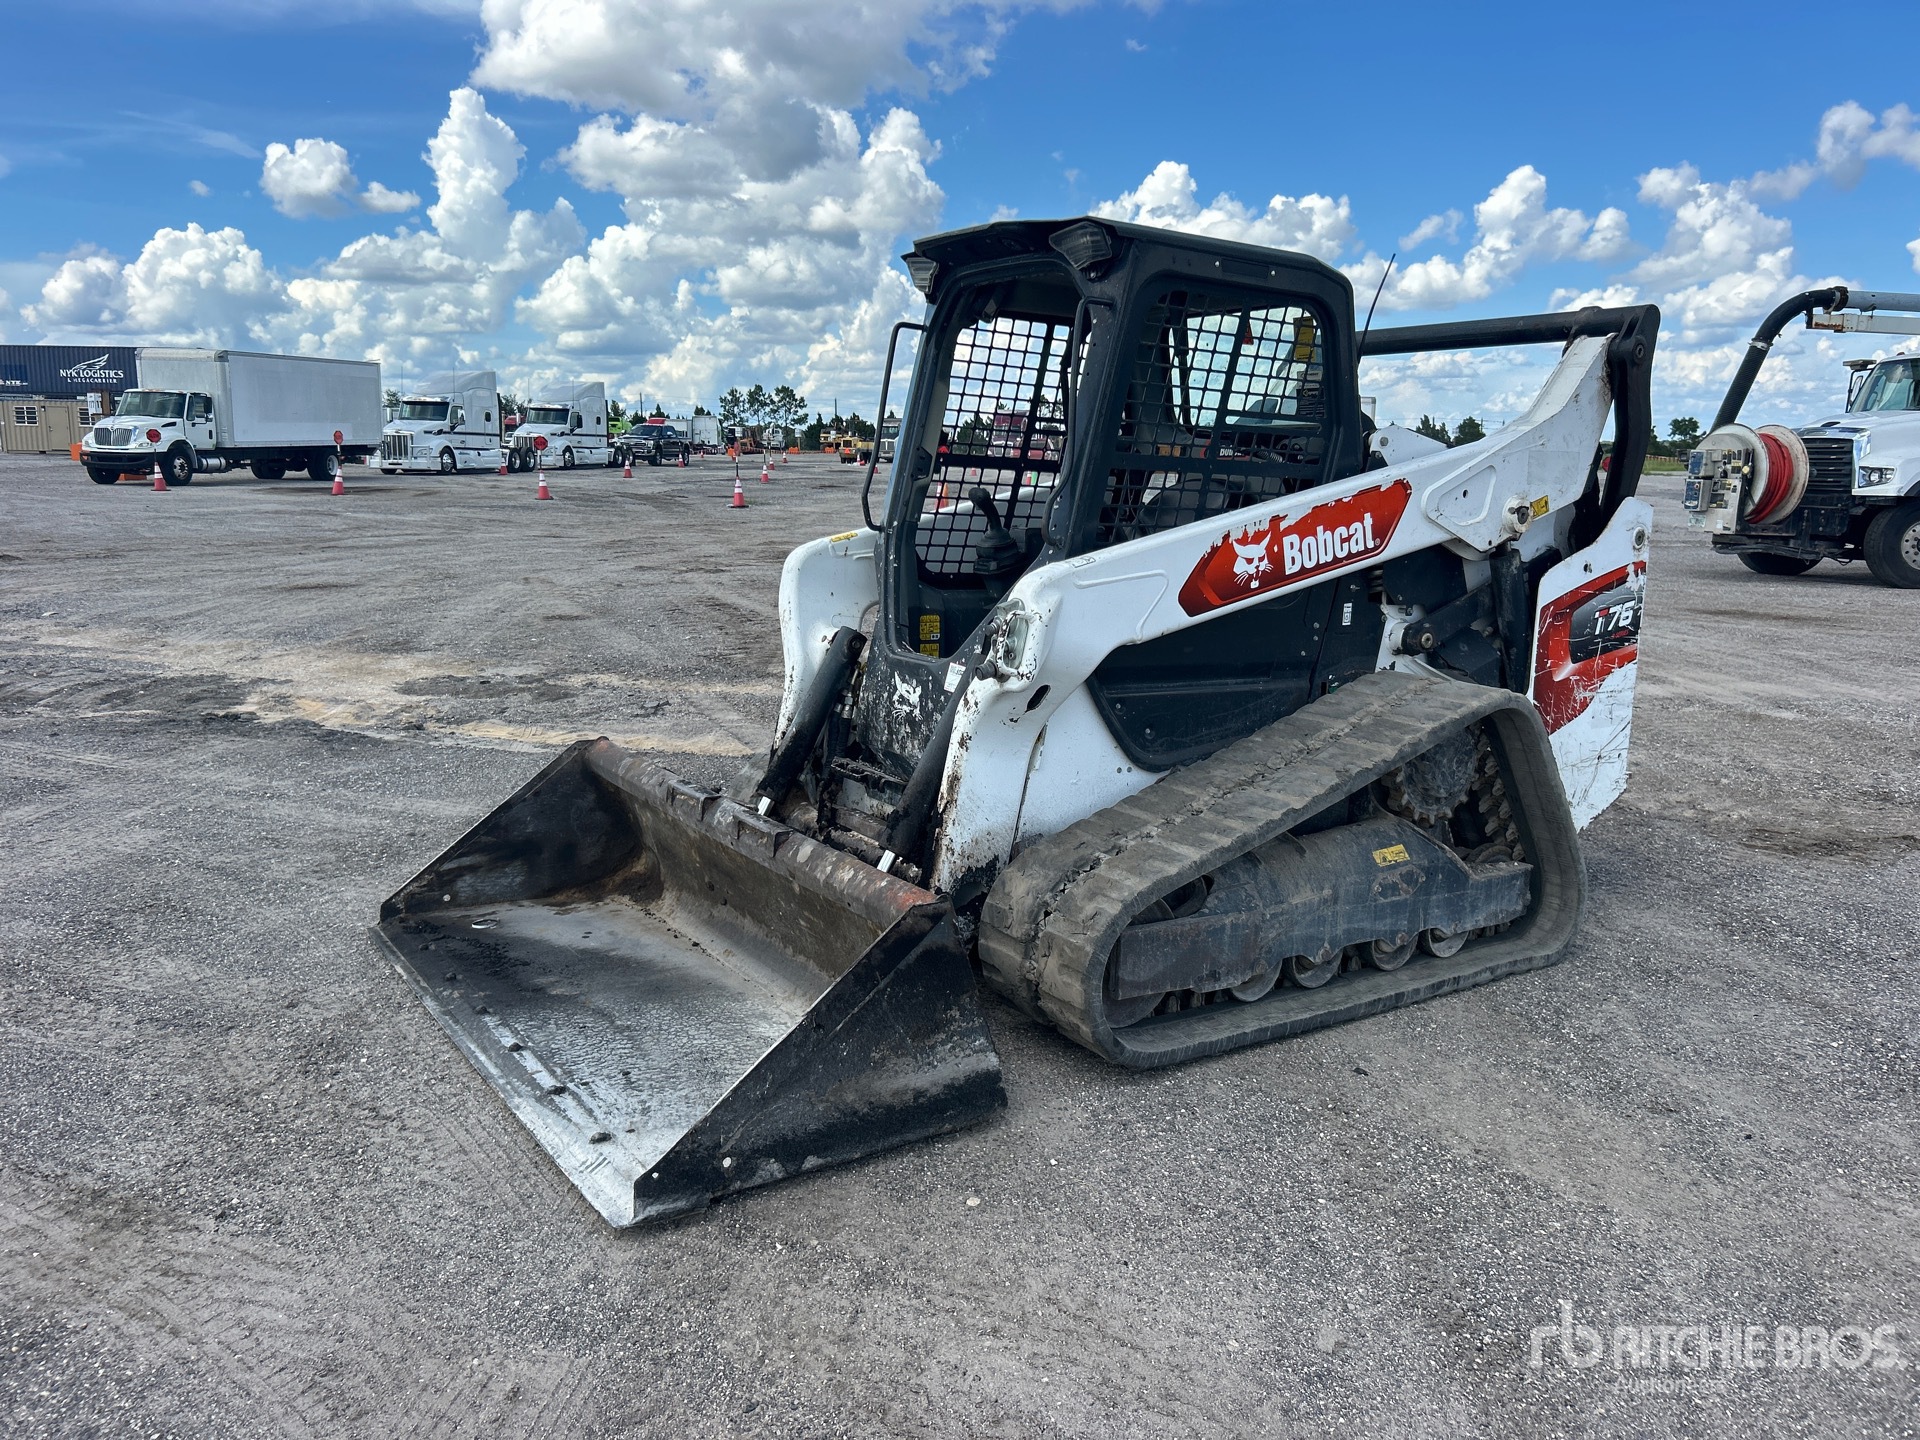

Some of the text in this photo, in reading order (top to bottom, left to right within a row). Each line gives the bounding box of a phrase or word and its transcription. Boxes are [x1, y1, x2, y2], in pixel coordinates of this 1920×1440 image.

[60, 369, 124, 379] NYK LOGISTICS
[1283, 512, 1375, 576] Bobcat
